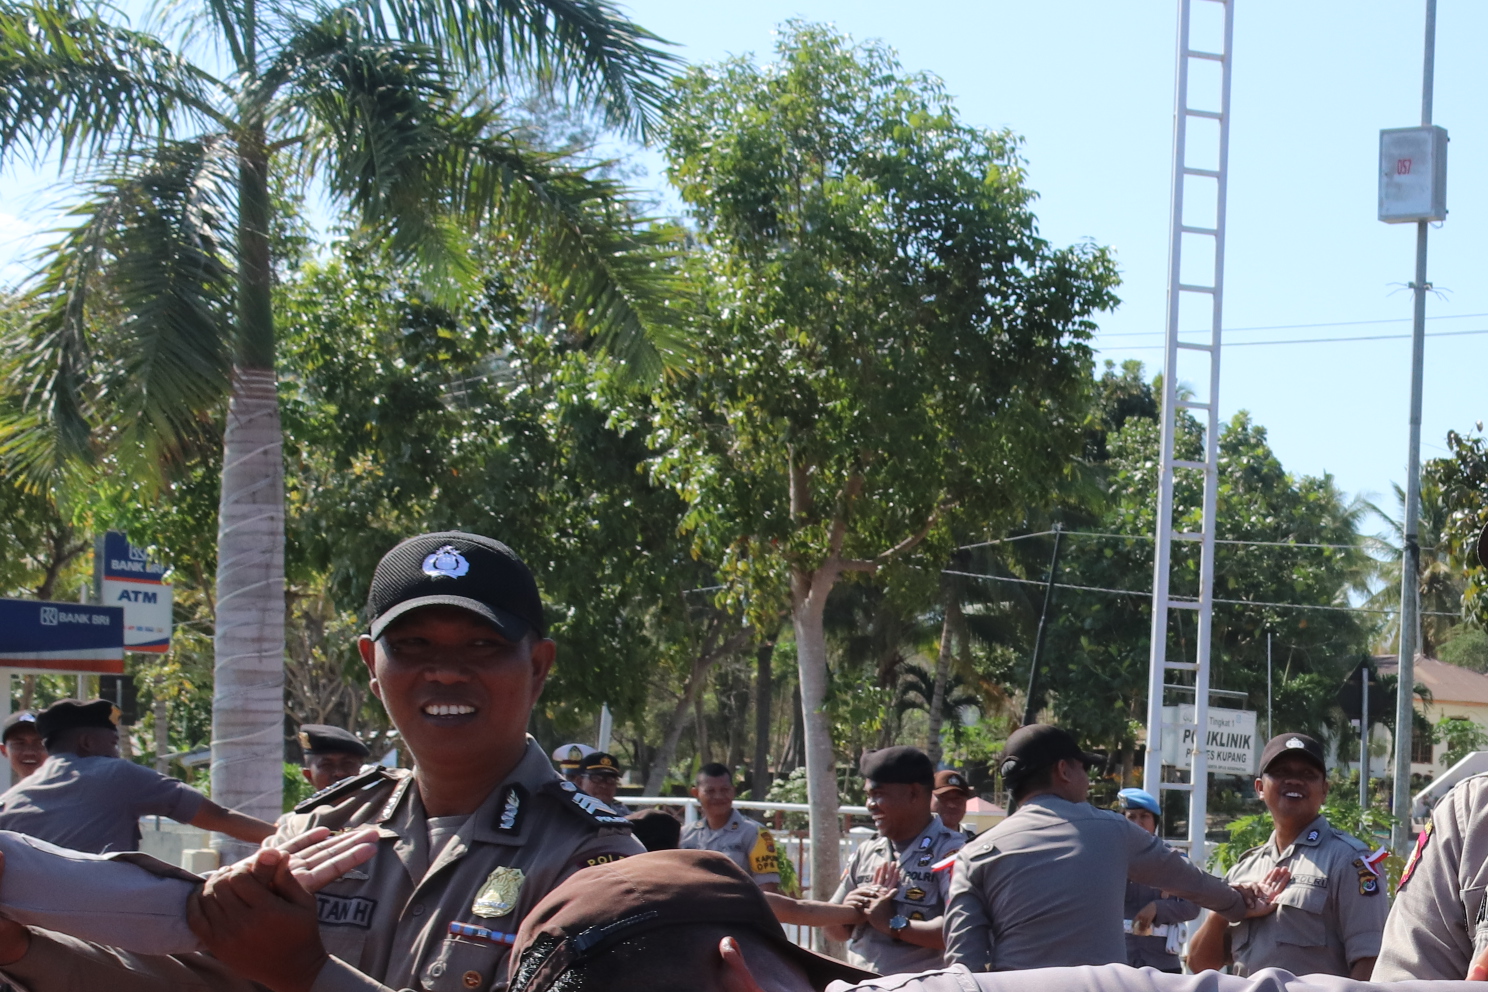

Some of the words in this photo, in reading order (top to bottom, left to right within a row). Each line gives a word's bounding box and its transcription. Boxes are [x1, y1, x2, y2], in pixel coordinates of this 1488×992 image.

[110, 559, 144, 572] BANK
[117, 589, 158, 604] ATM
[58, 611, 91, 625] BANK
[91, 614, 110, 626] BRI
[1182, 728, 1252, 750] PIKLINIK
[1216, 750, 1247, 764] KUPANG
